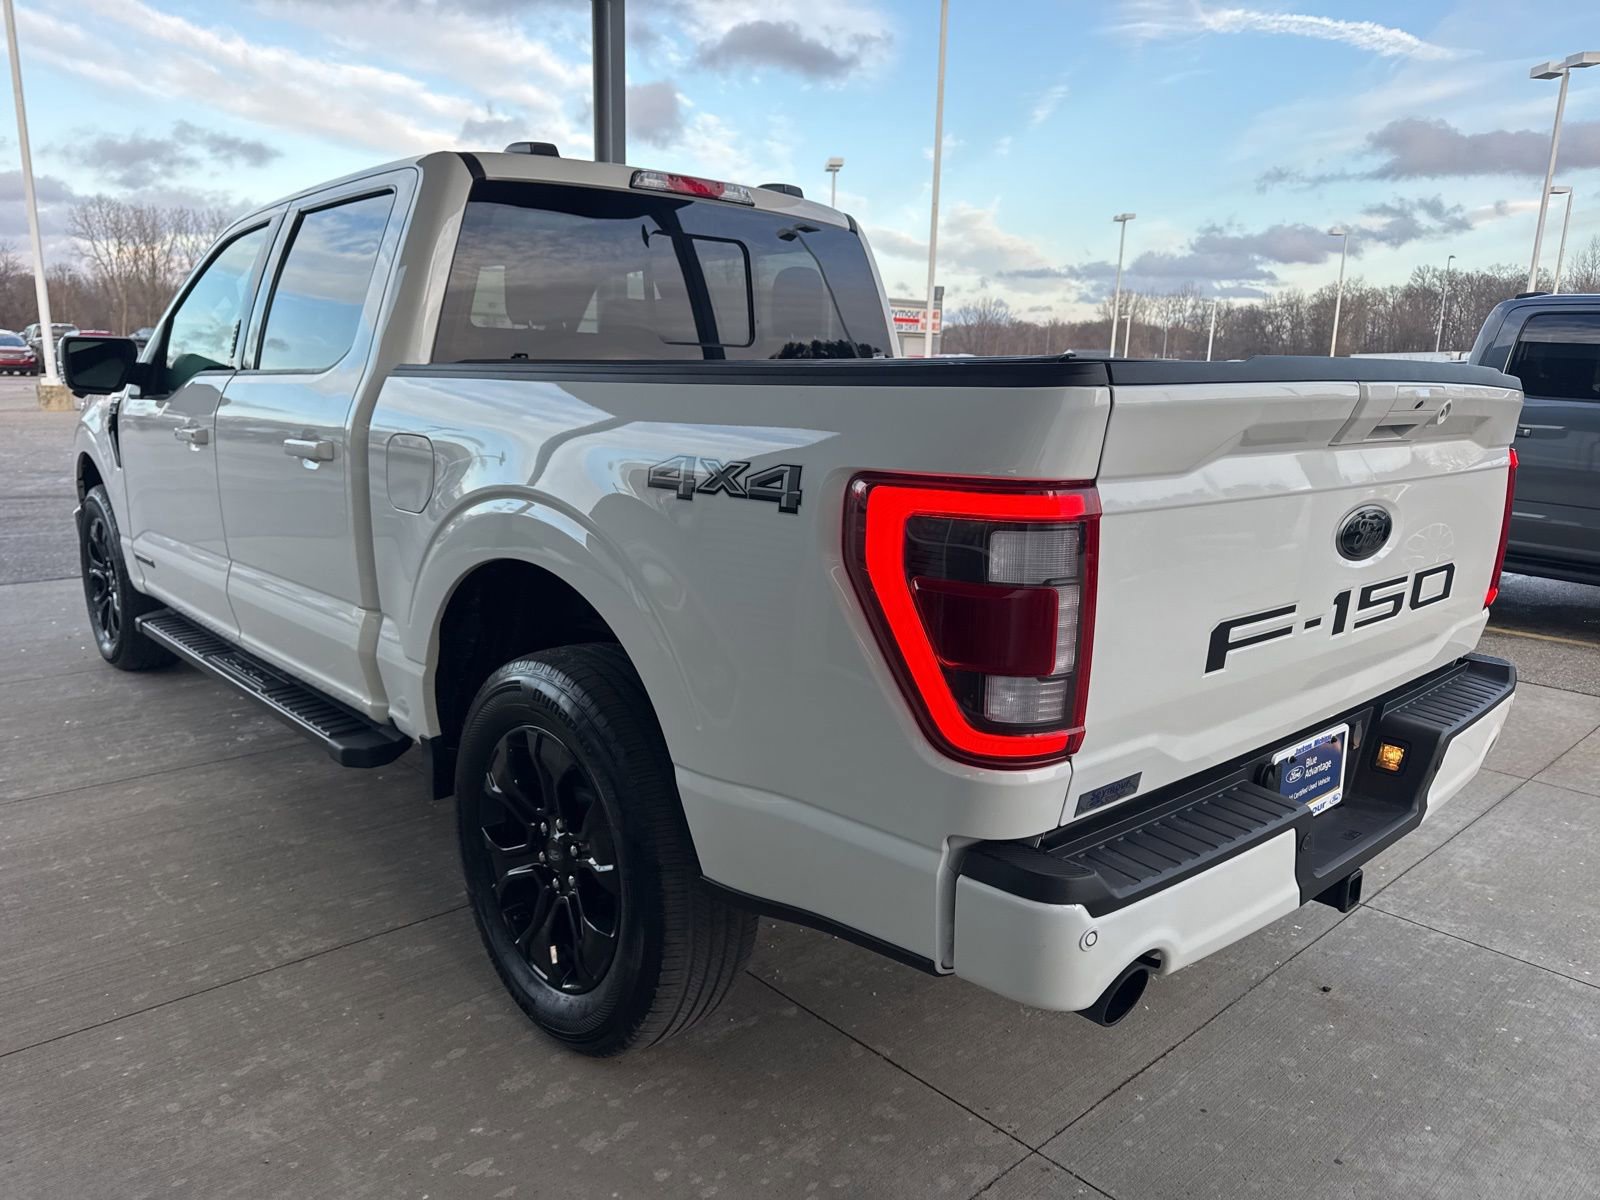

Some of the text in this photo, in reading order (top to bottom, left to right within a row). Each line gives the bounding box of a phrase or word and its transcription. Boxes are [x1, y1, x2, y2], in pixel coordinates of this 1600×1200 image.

[1204, 562, 1455, 674] F-150
[1305, 756, 1318, 768] Blue
[1288, 768, 1303, 782] Ford
[1304, 760, 1332, 779] Advantage
[1317, 776, 1331, 787] Vehicle
